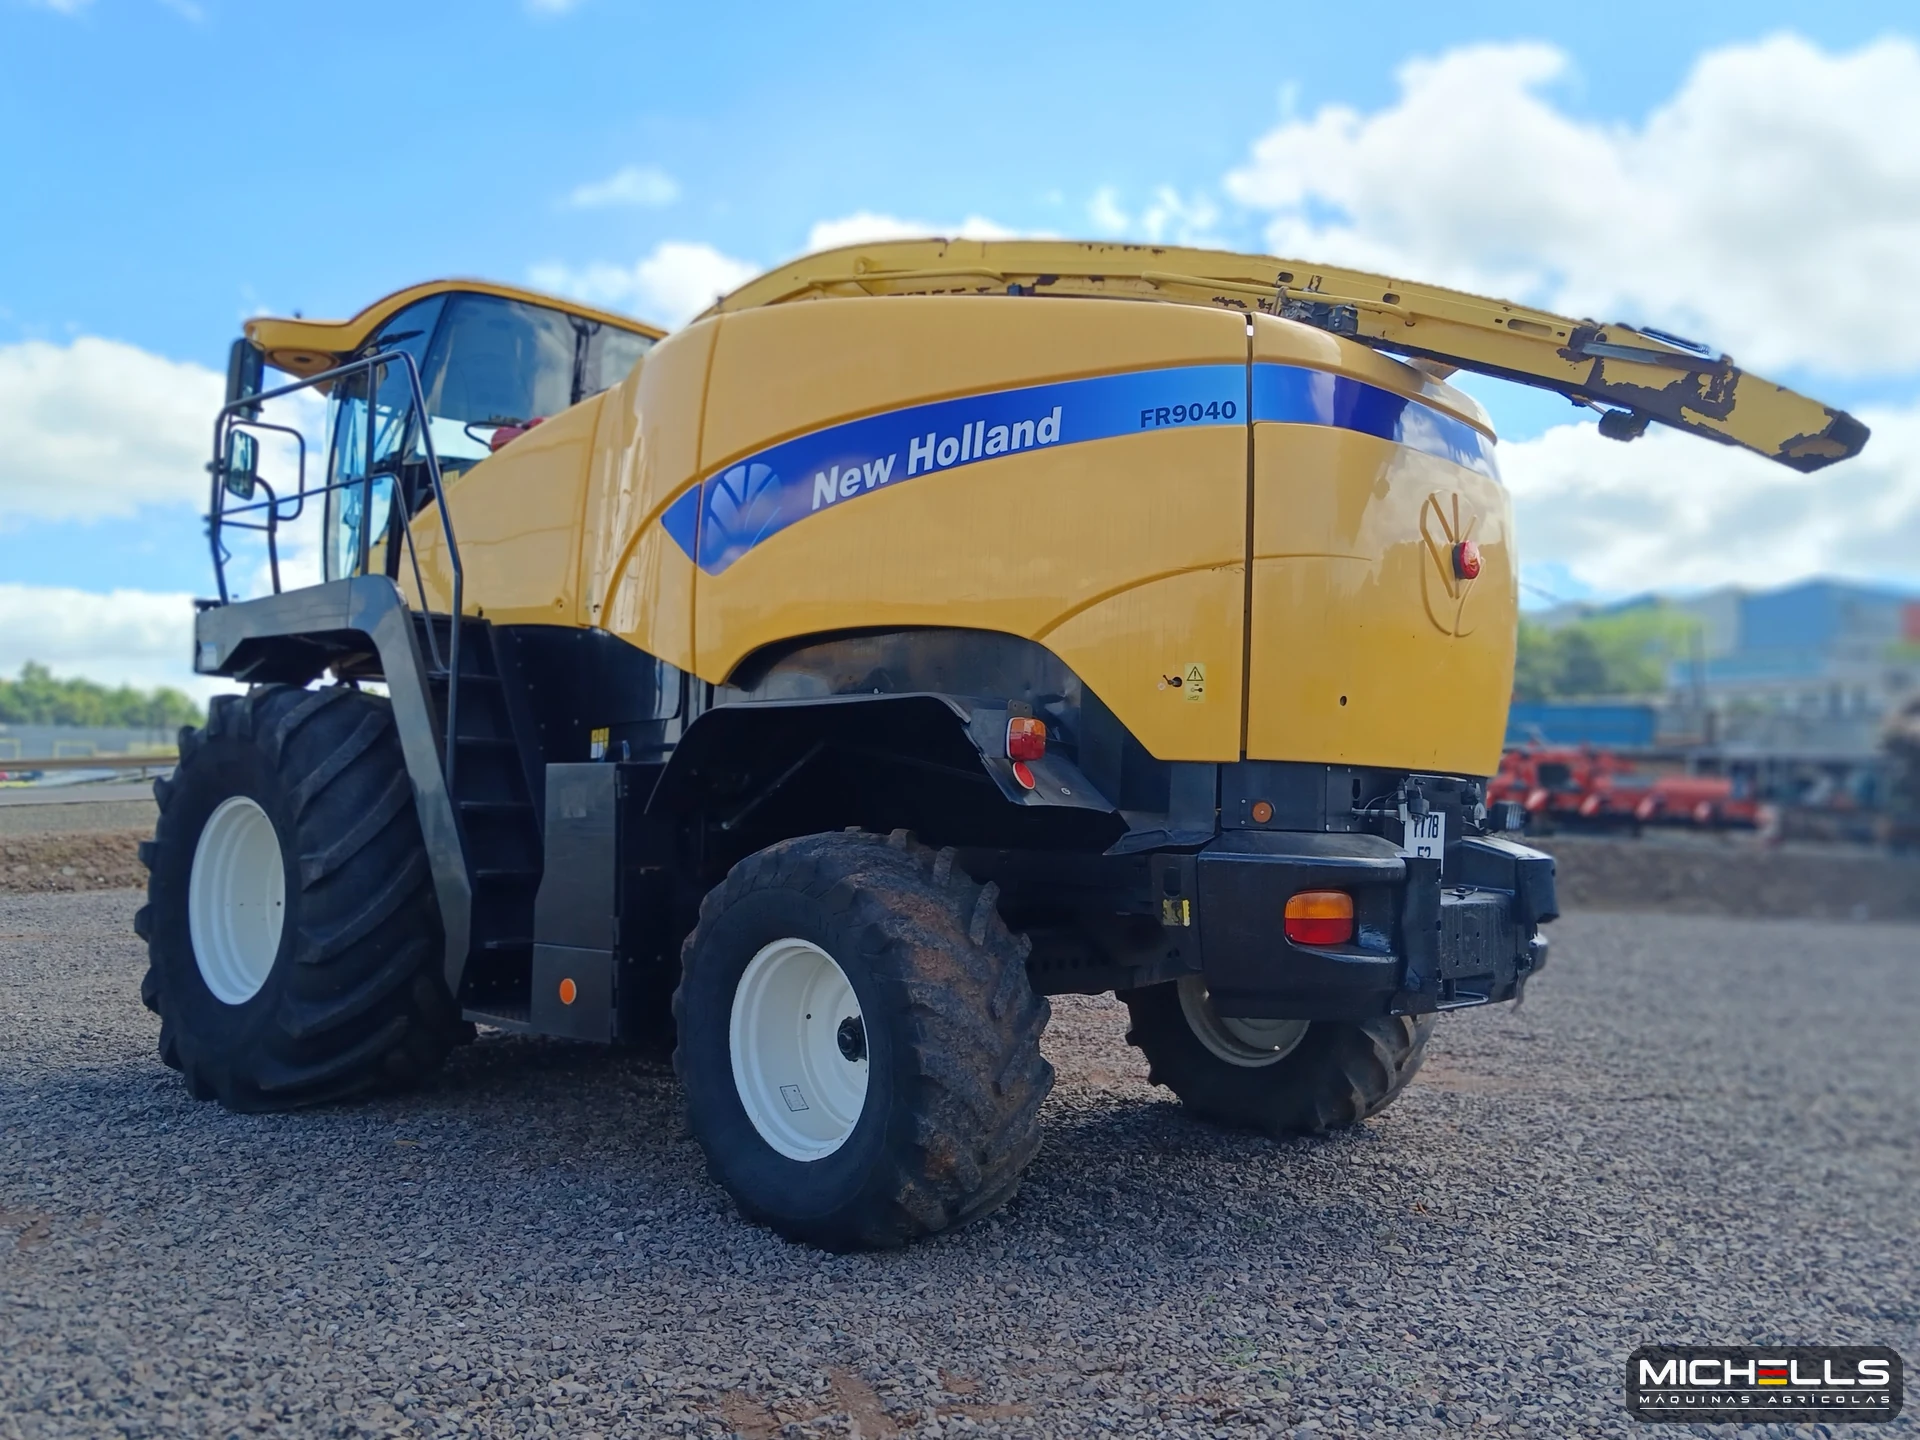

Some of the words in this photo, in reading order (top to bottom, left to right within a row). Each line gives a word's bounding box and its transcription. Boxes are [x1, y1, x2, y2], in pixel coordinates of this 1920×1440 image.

[1140, 400, 1237, 429] FR9040
[811, 453, 897, 511] New
[907, 406, 1063, 476] Holland
